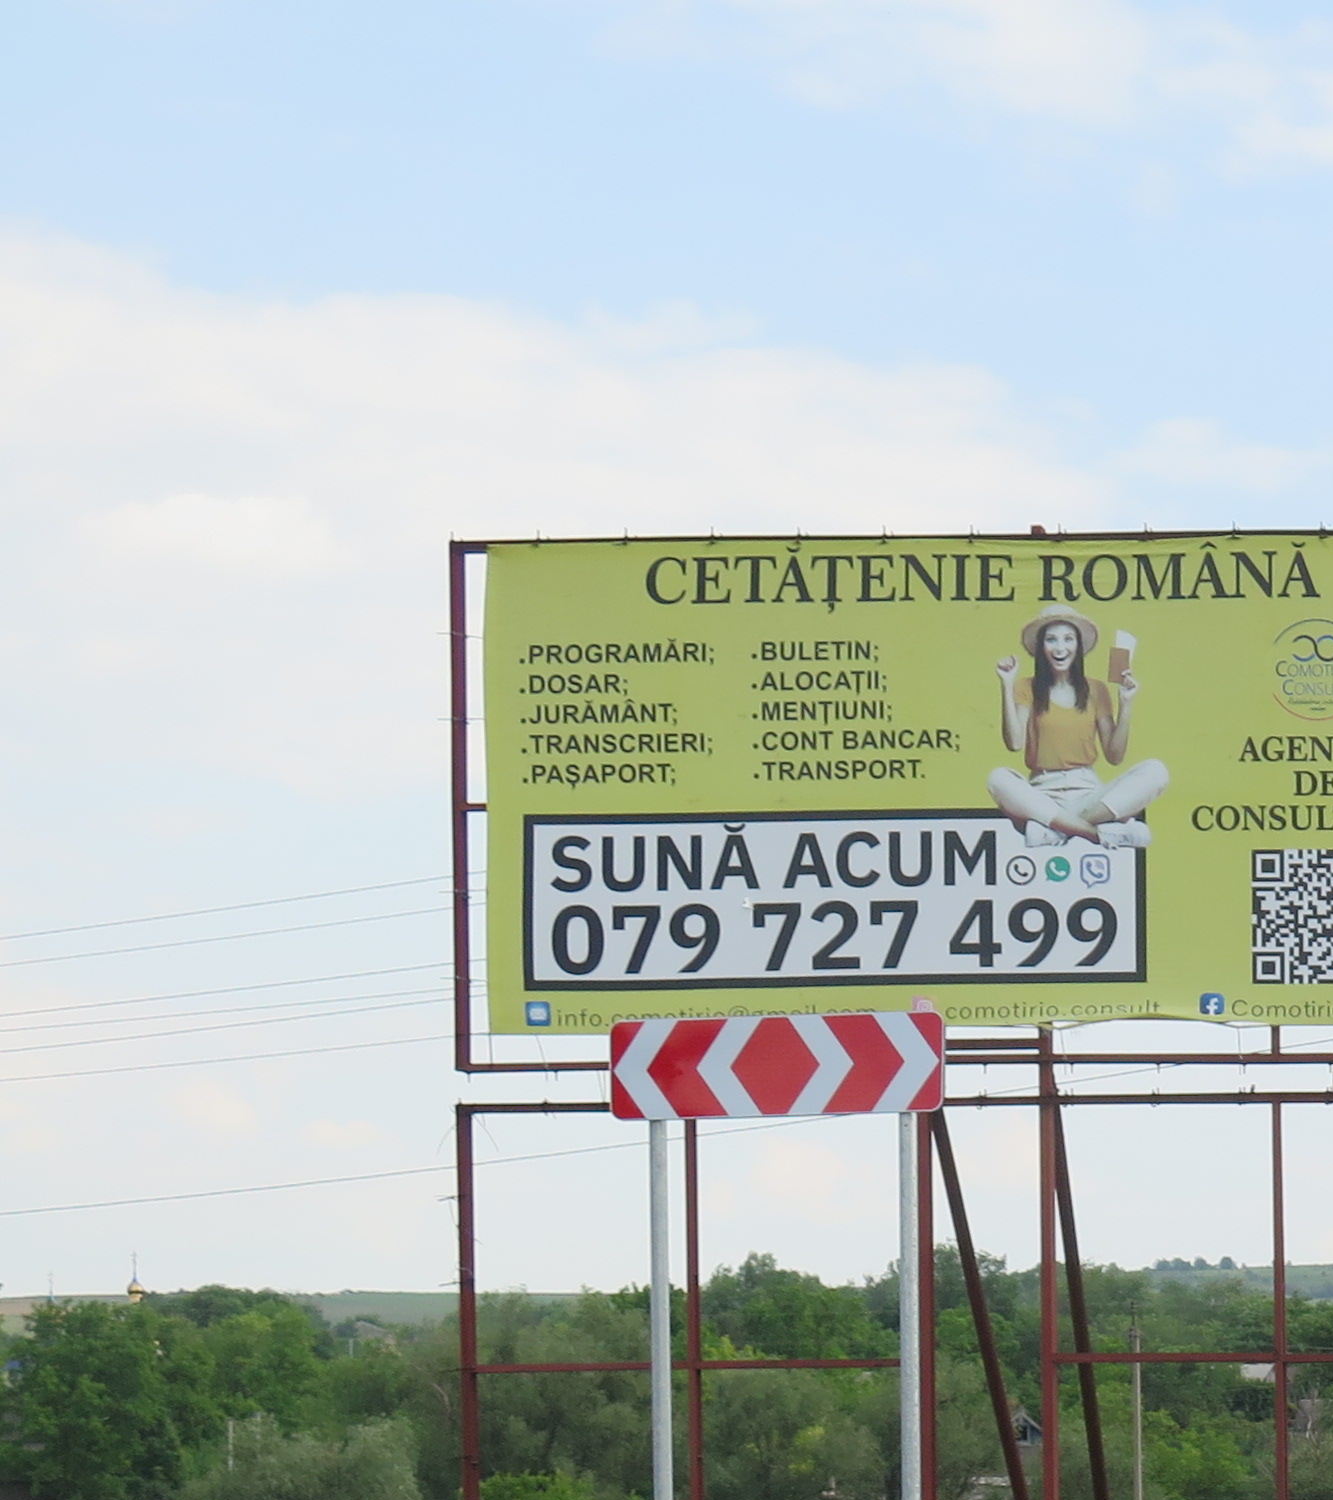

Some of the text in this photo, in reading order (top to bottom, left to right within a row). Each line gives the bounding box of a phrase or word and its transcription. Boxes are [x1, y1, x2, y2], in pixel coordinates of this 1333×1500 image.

[645, 543, 1321, 613] CETĂȚENIE ROMÂNĂ
[842, 729, 961, 752] BANCAR;
[550, 823, 997, 893] SUNĂ ACUM
[551, 897, 1119, 976] 079 727 499
